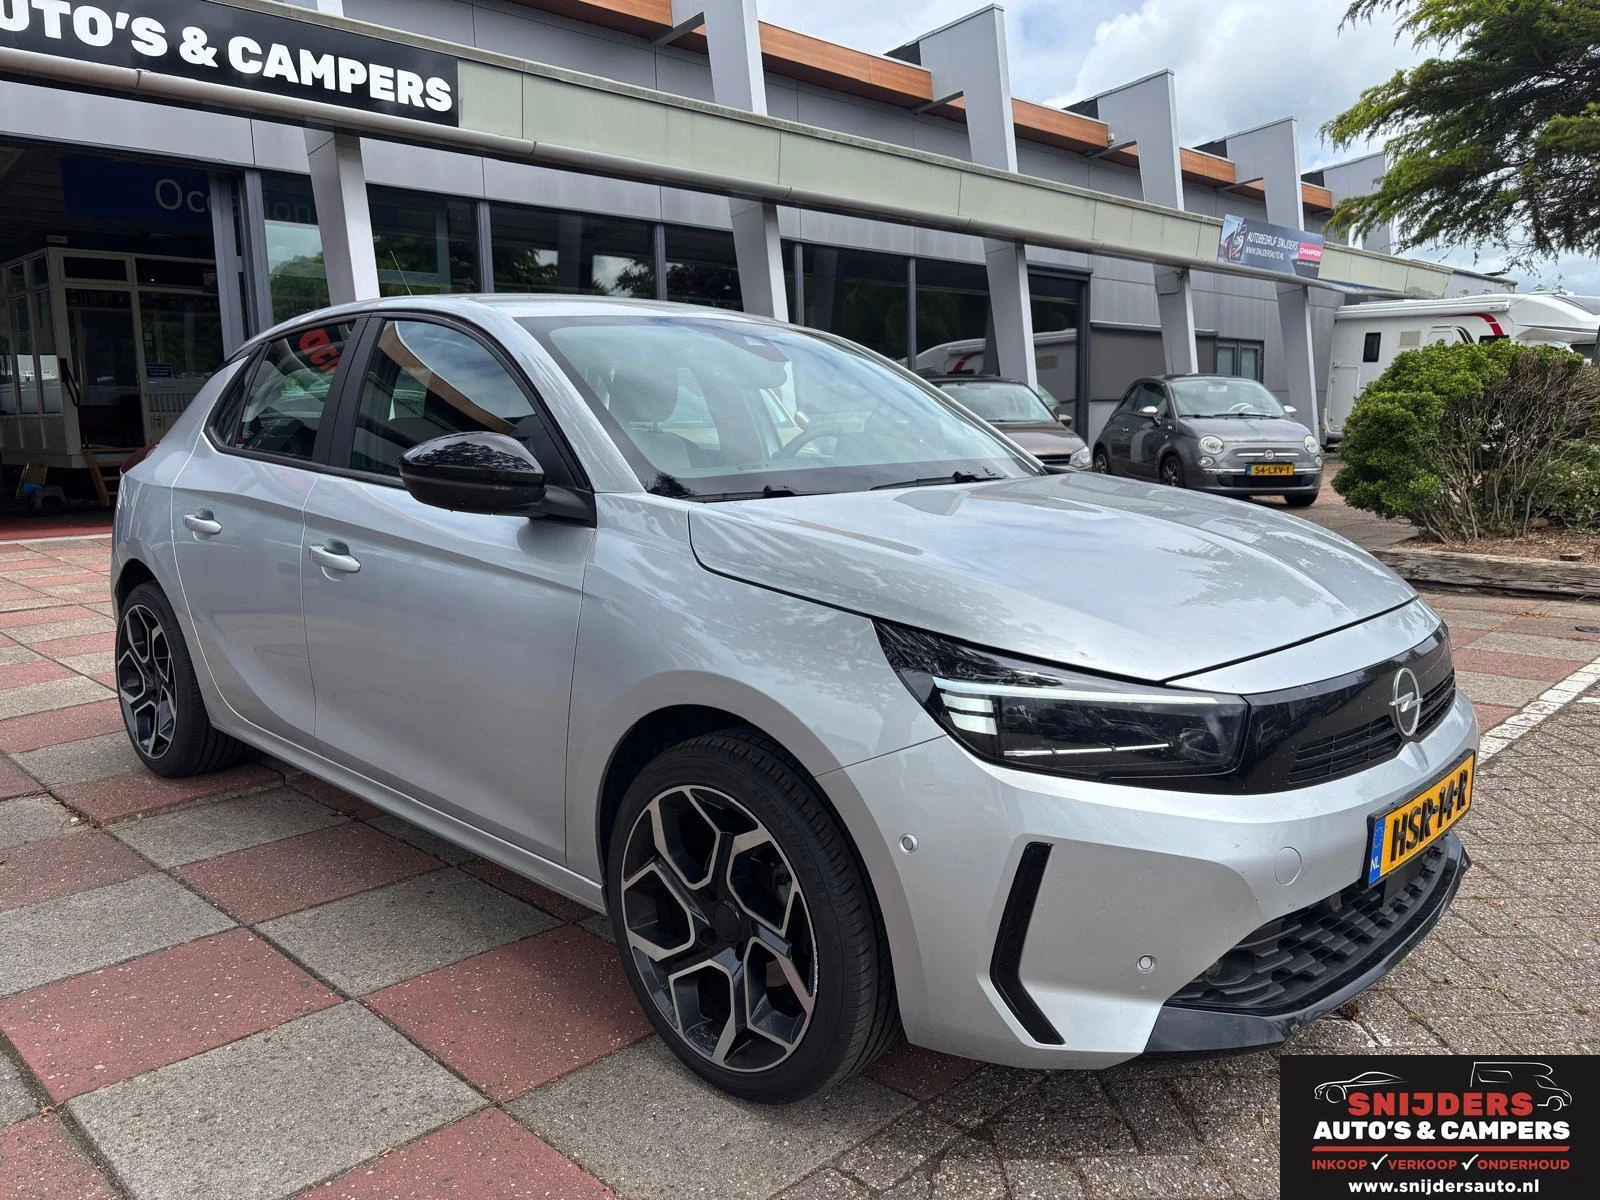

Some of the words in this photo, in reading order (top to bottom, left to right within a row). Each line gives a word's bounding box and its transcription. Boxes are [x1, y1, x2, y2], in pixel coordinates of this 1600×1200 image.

[179, 26, 218, 68] &
[228, 36, 453, 112] CAMPERS
[1246, 232, 1278, 247] AUTOBEDRIJF
[1277, 237, 1299, 251] SNIJDERS
[1299, 248, 1322, 257] CHAMPION
[1390, 769, 1469, 862] HSR-14-R
[1370, 856, 1380, 871] NL
